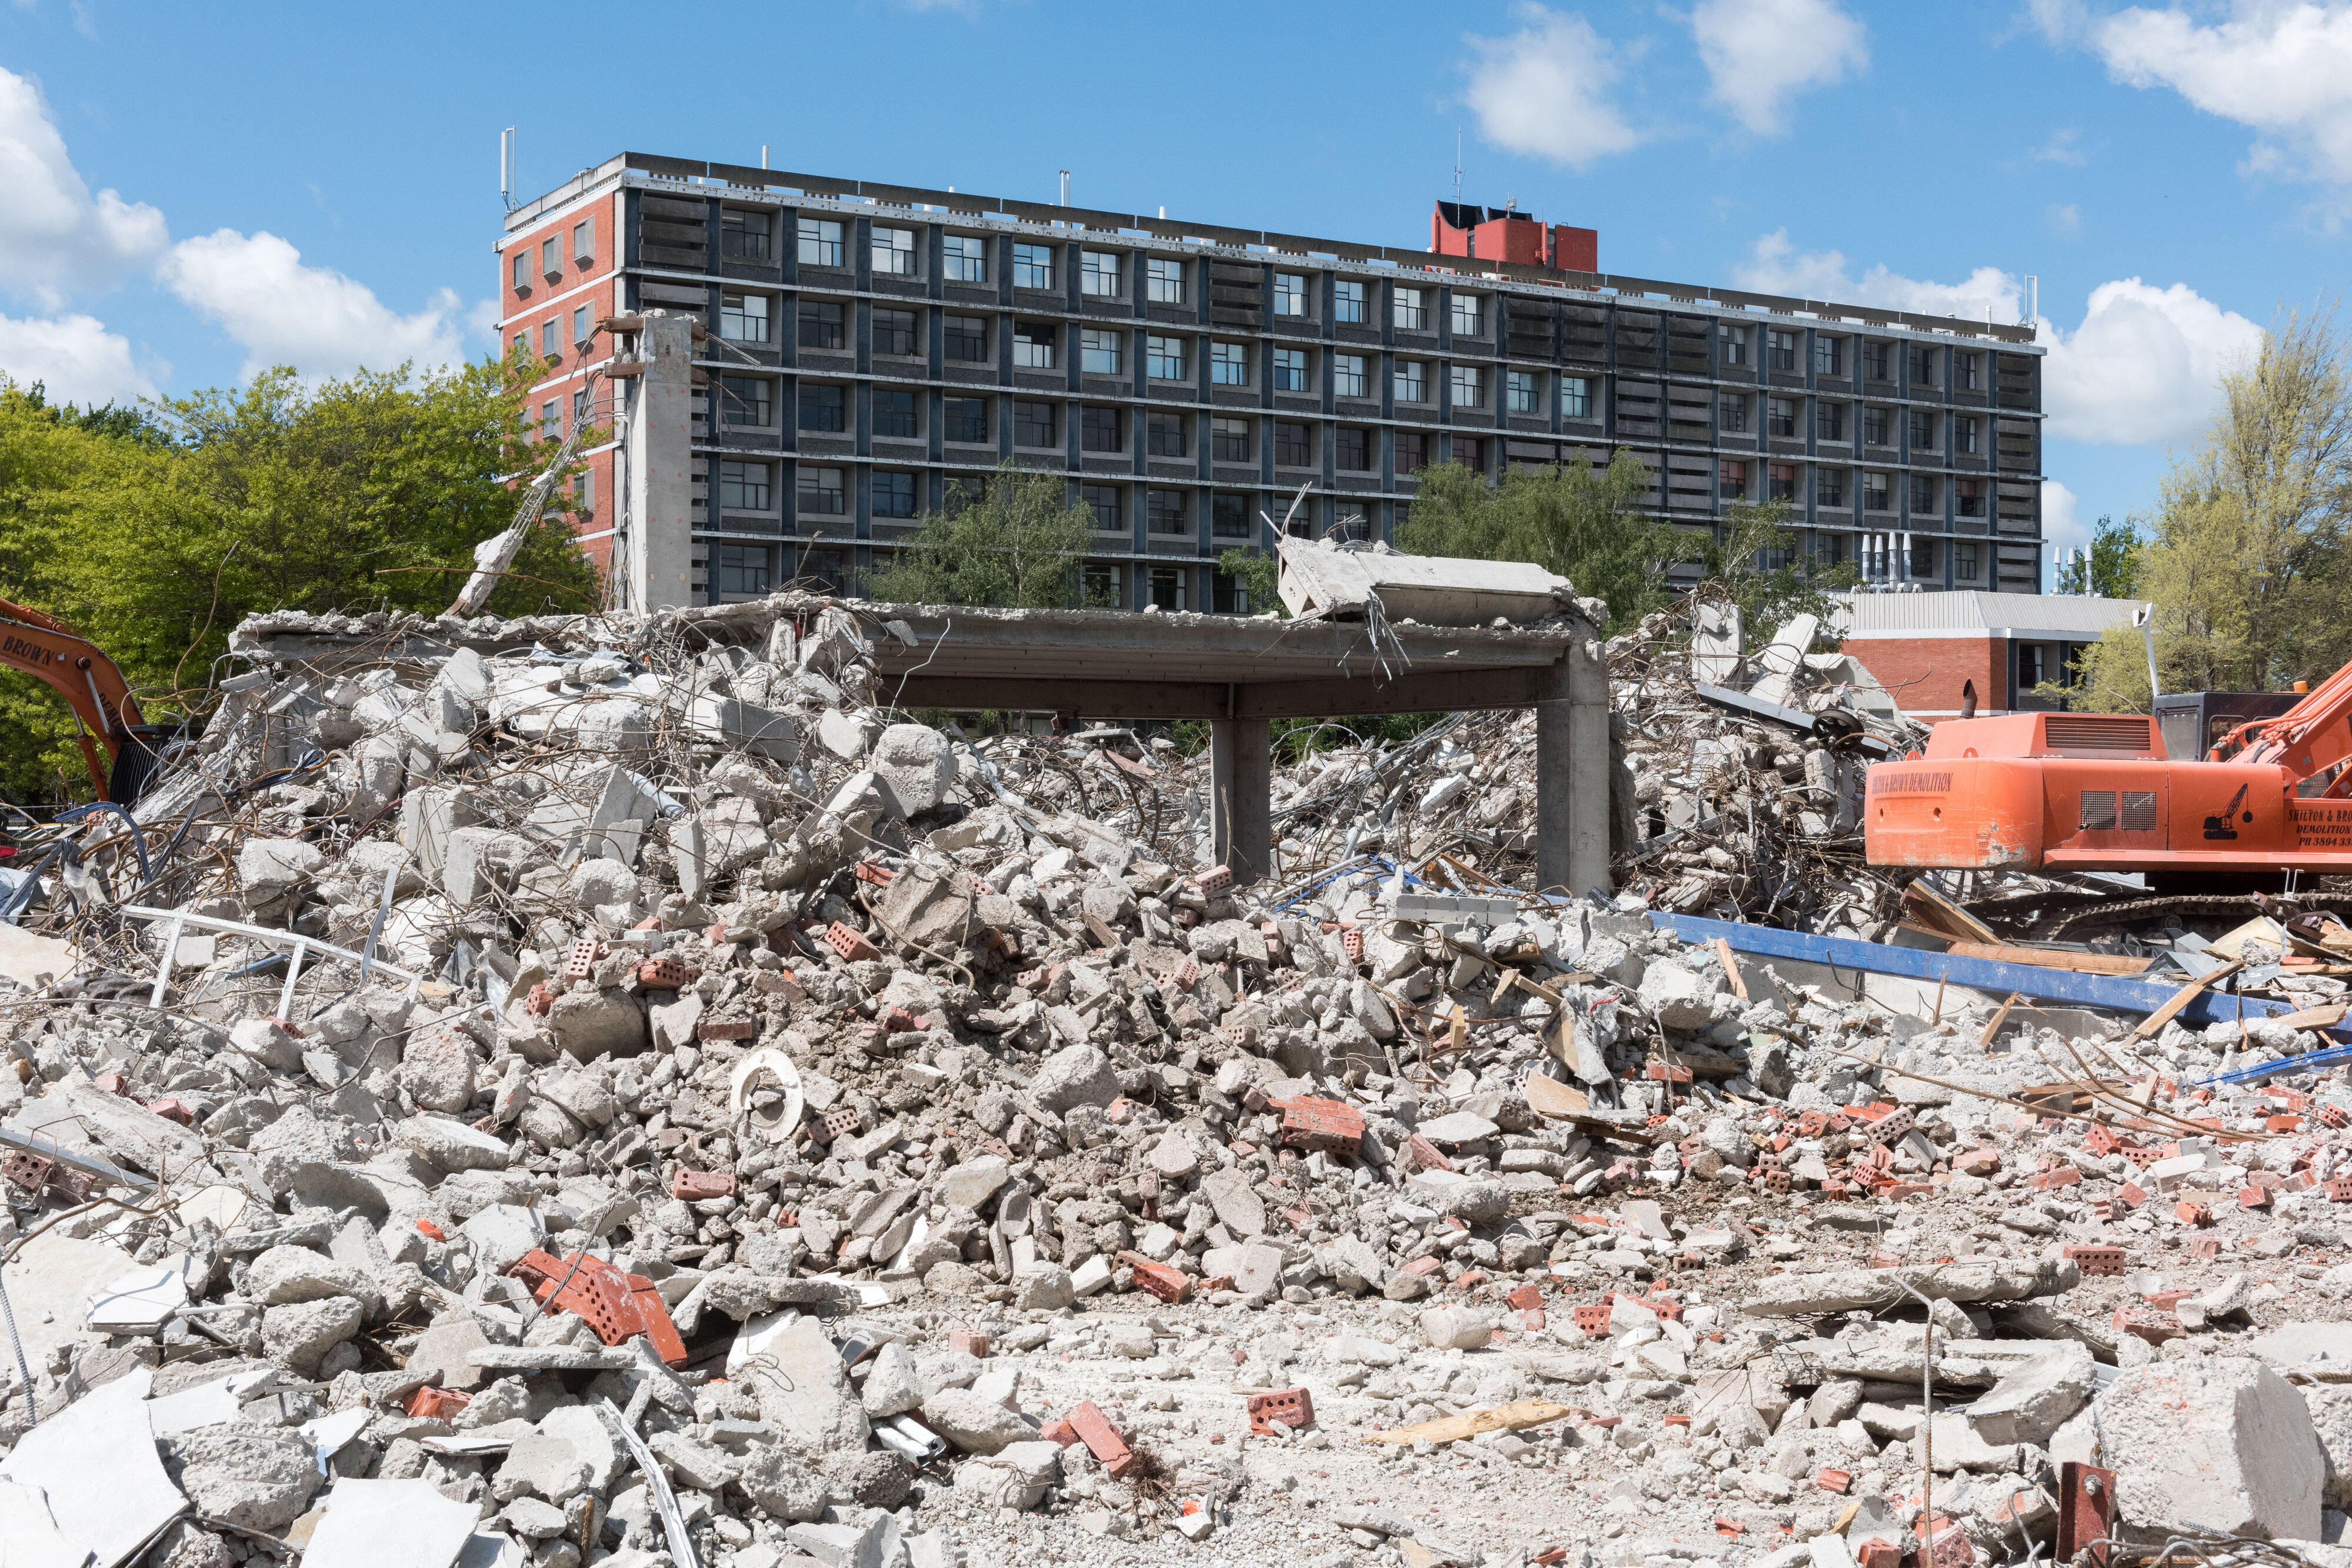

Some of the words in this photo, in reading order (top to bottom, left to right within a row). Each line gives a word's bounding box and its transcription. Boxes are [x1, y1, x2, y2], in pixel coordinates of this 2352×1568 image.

[3, 635, 55, 666] BROWN
[1889, 773, 1909, 792] BROWN
[1909, 772, 1953, 792] DEMOLITION
[2288, 809, 2324, 822] SHILTON
[2327, 810, 2333, 822] &
[2296, 825, 2351, 834] DEMOLITION
[2298, 838, 2311, 846] PH
[2313, 838, 2337, 846] 3894
[2339, 838, 2352, 846] 33
